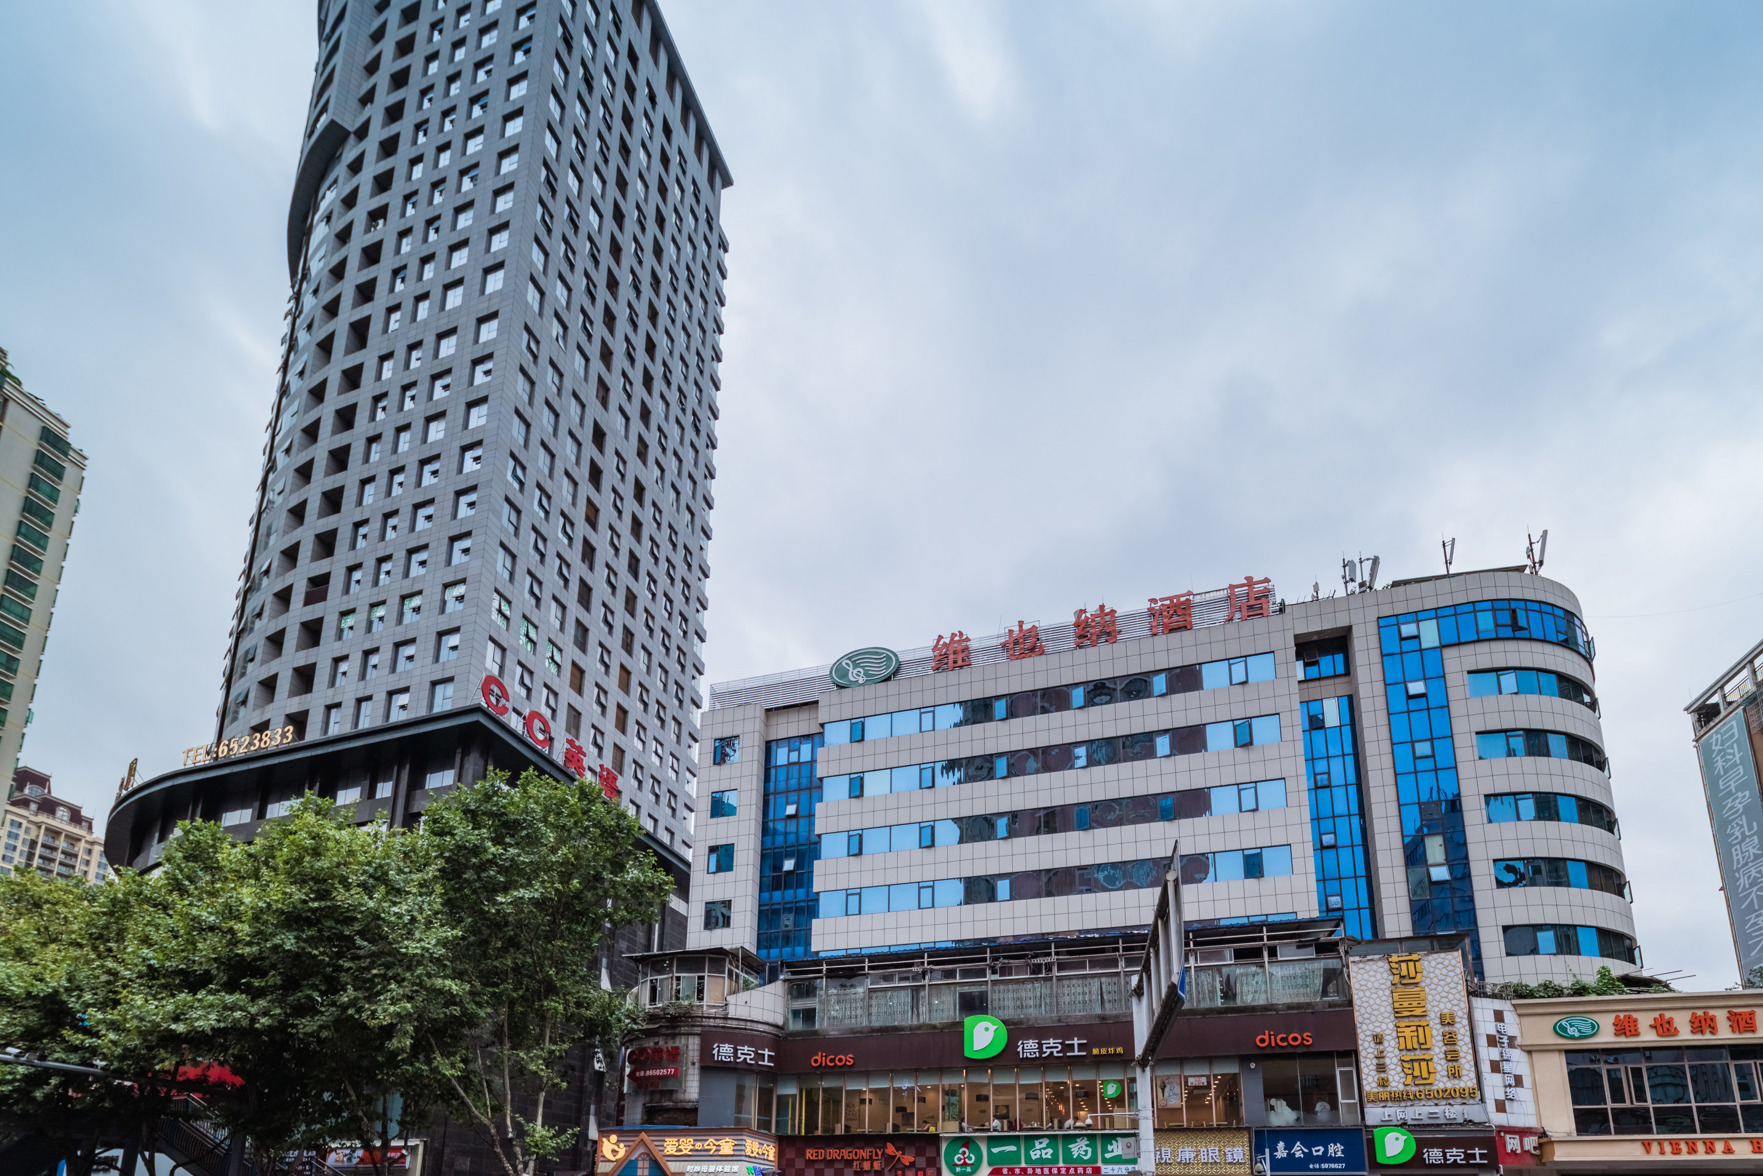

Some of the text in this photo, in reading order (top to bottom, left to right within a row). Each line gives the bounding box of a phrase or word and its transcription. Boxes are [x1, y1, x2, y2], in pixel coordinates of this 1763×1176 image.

[930, 575, 1271, 672] 维也纳酒店
[1612, 1009, 1759, 1038] 维也纳酒
[1255, 1030, 1313, 1047] dicos
[1440, 1012, 1463, 1078] 美容会所
[712, 1043, 775, 1067] 德克士
[1017, 1037, 1088, 1059] 德克士
[810, 1052, 854, 1068] dicos
[1273, 1140, 1345, 1160] 嘉会口腔
[1505, 1134, 1541, 1156] 网吧
[1641, 1139, 1735, 1154] VIENNA
[806, 1149, 883, 1160] RED DRAGONFLY
[1154, 1147, 1245, 1163] 視康眼鏡
[1422, 1147, 1488, 1164] 德克士
[852, 1160, 882, 1171] 红蜻蜓
